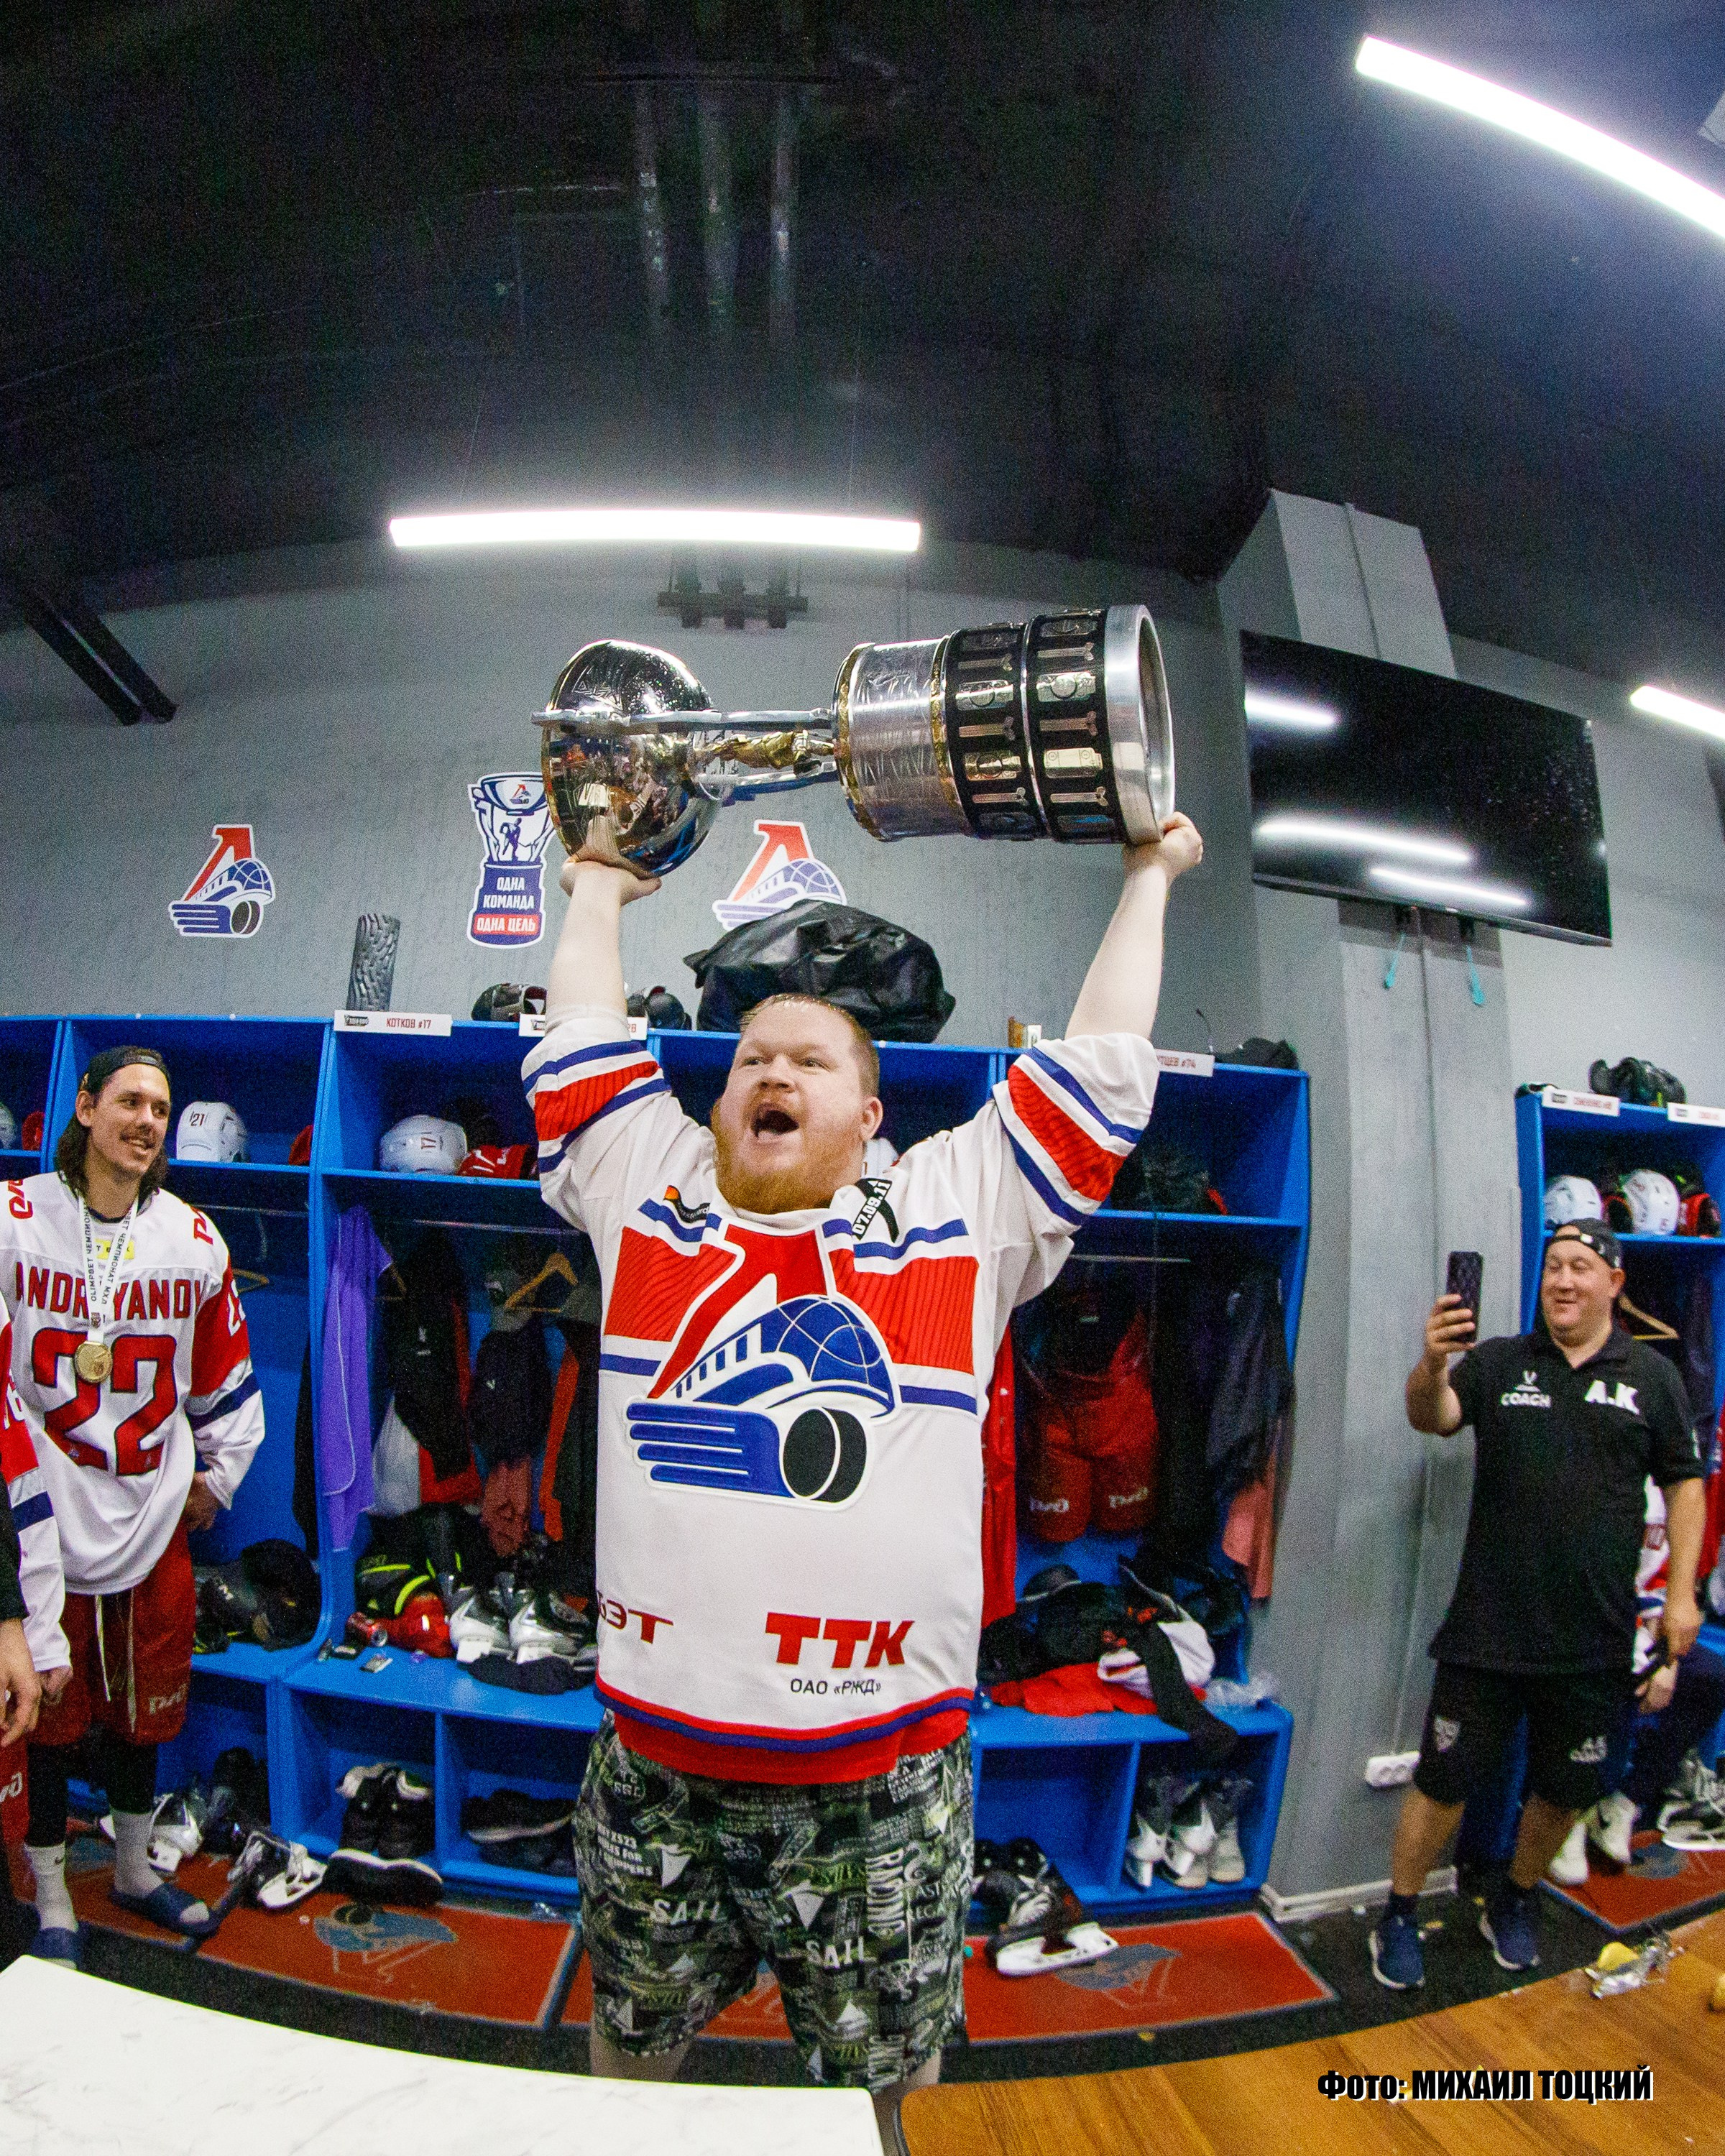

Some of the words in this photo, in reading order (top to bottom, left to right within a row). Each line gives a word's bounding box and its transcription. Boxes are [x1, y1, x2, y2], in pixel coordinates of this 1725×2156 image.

[496, 877, 525, 891] ОДНА
[483, 894, 535, 910] КОМАНДА
[476, 917, 505, 933] ОДНА
[507, 918, 536, 933] ЦЕЛЬ
[386, 1018, 416, 1028] КОТКОВ
[852, 1181, 892, 1235] 07.09.11
[31, 1327, 179, 1476] 22
[1501, 1391, 1552, 1409] COACH
[790, 1678, 829, 1695] ОАО
